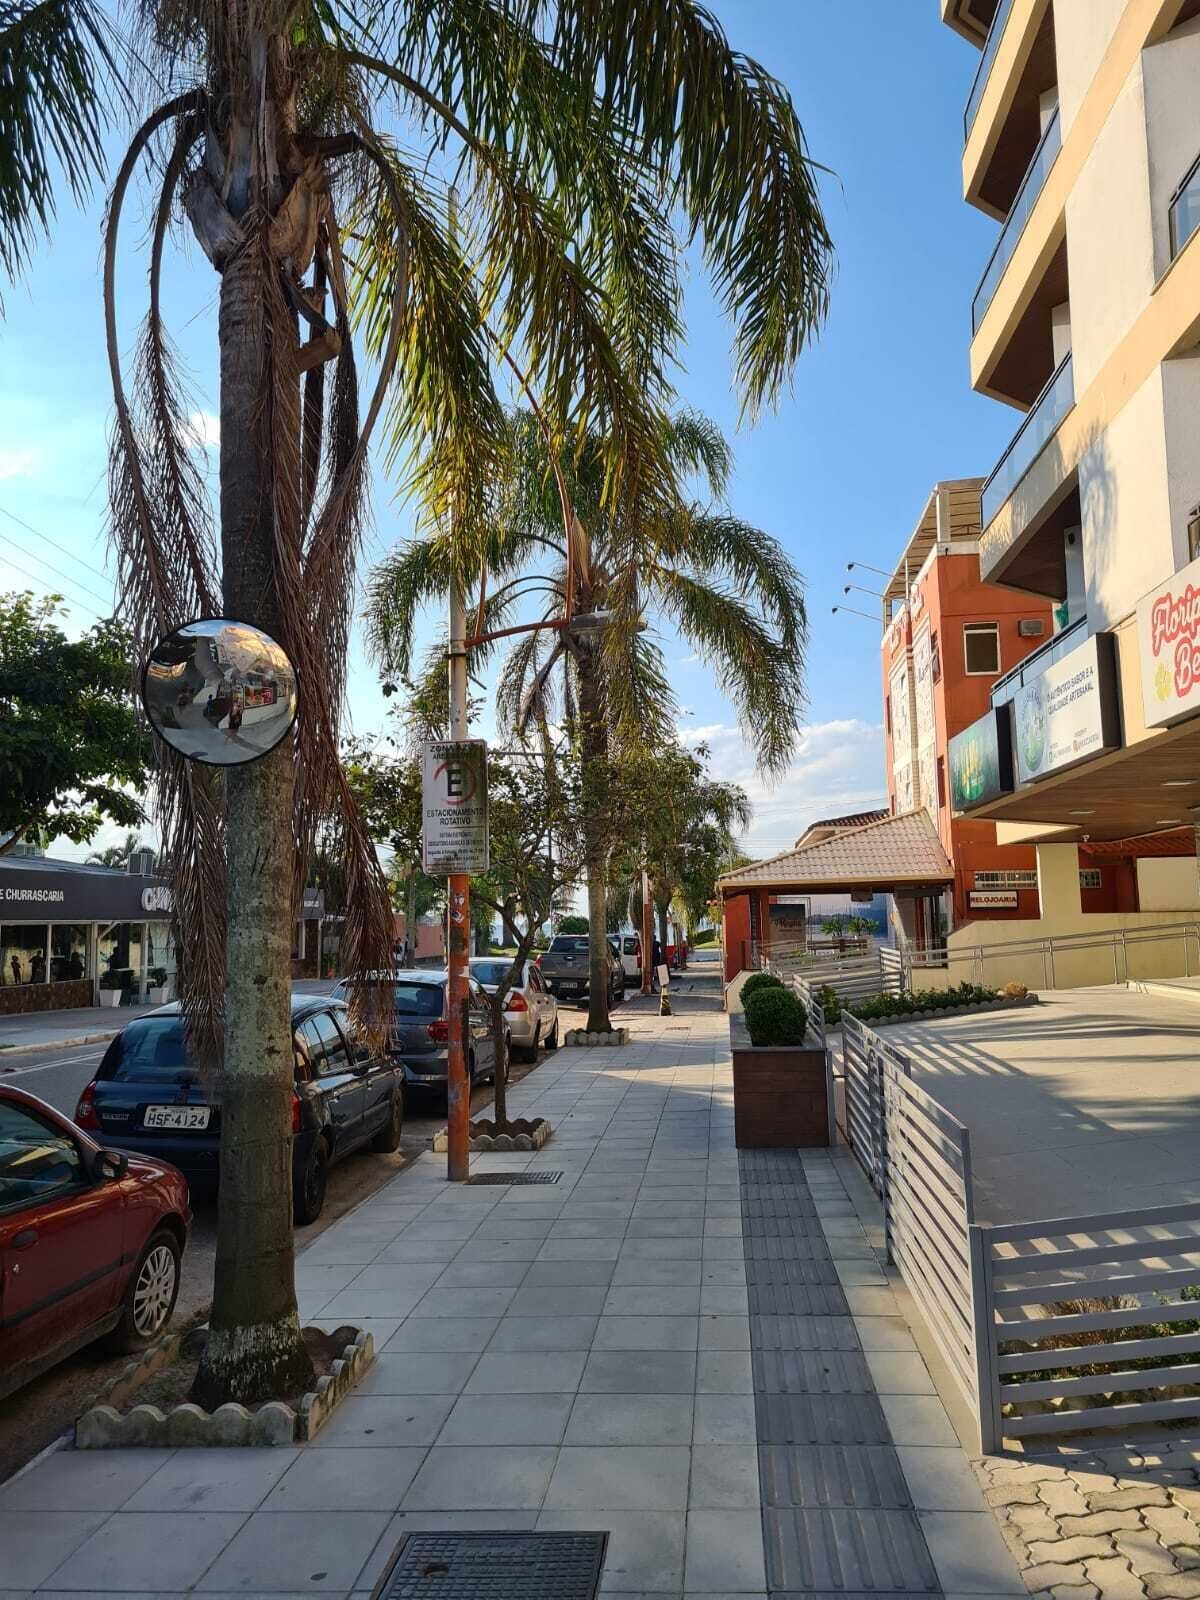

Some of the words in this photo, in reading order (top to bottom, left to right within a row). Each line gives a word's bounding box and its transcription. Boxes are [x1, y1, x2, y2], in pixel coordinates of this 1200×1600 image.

[446, 769, 463, 797] E
[426, 807, 484, 818] ESTACIONAMENTO
[439, 816, 471, 826] ROTATIVO
[5, 887, 65, 902] CHURRASCARIA
[969, 895, 1017, 904] RELOJOARIA
